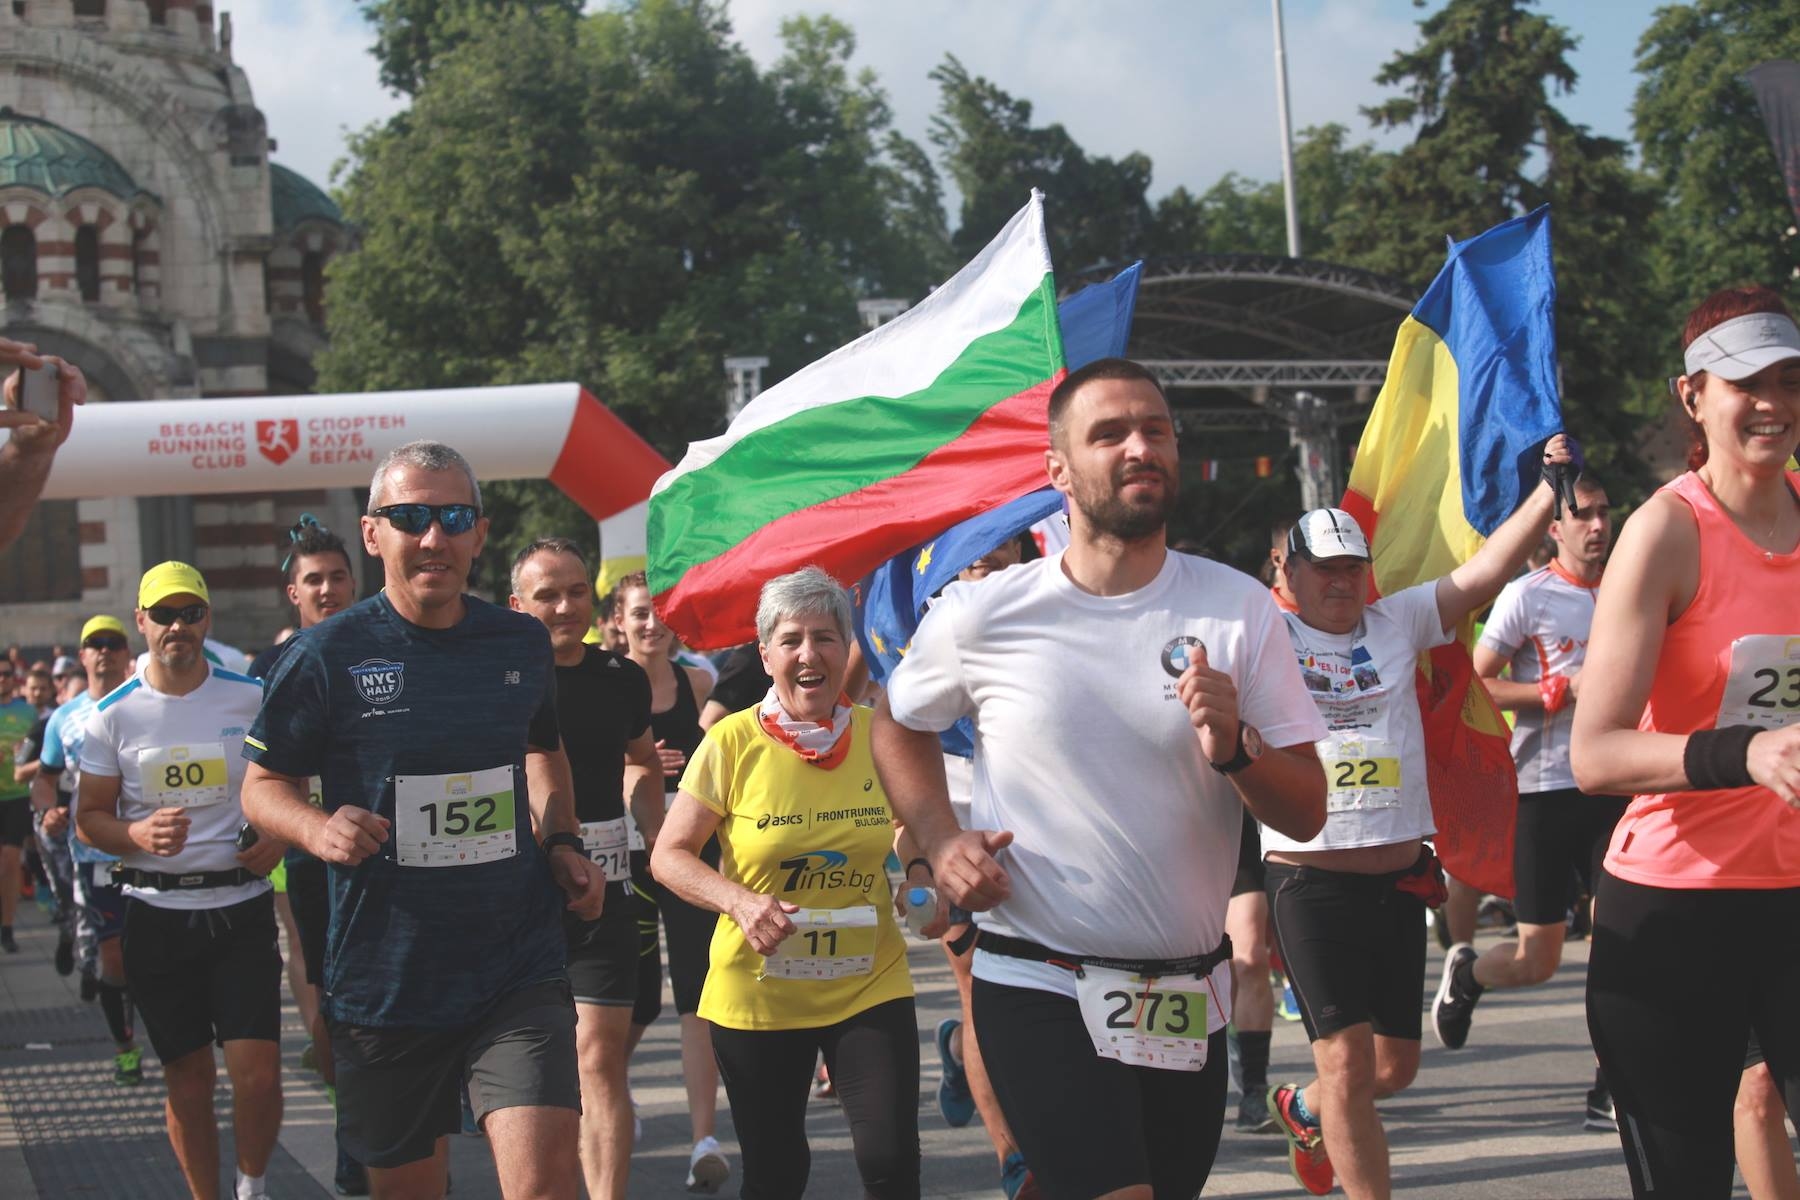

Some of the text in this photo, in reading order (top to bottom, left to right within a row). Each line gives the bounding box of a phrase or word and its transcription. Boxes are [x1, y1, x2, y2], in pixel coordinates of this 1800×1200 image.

[160, 421, 246, 437] BEGACH
[307, 415, 406, 431] СПОРТЕН
[148, 436, 247, 455] RUNNING
[309, 432, 364, 448] КЛУБ
[191, 454, 247, 470] CLUB
[309, 448, 374, 465] БЕГАЧ
[361, 672, 396, 687] NYC
[366, 685, 395, 697] HALF
[1164, 693, 1177, 701] BM
[165, 763, 204, 788] 80
[1335, 760, 1380, 787] 22
[419, 797, 497, 836] 152
[771, 806, 886, 827] asics FRONTRUNNER
[855, 817, 890, 828] BULGARIA
[594, 850, 628, 876] 214
[780, 857, 876, 894] 7ins.bg
[803, 930, 837, 956] 11
[1103, 990, 1190, 1034] 273
